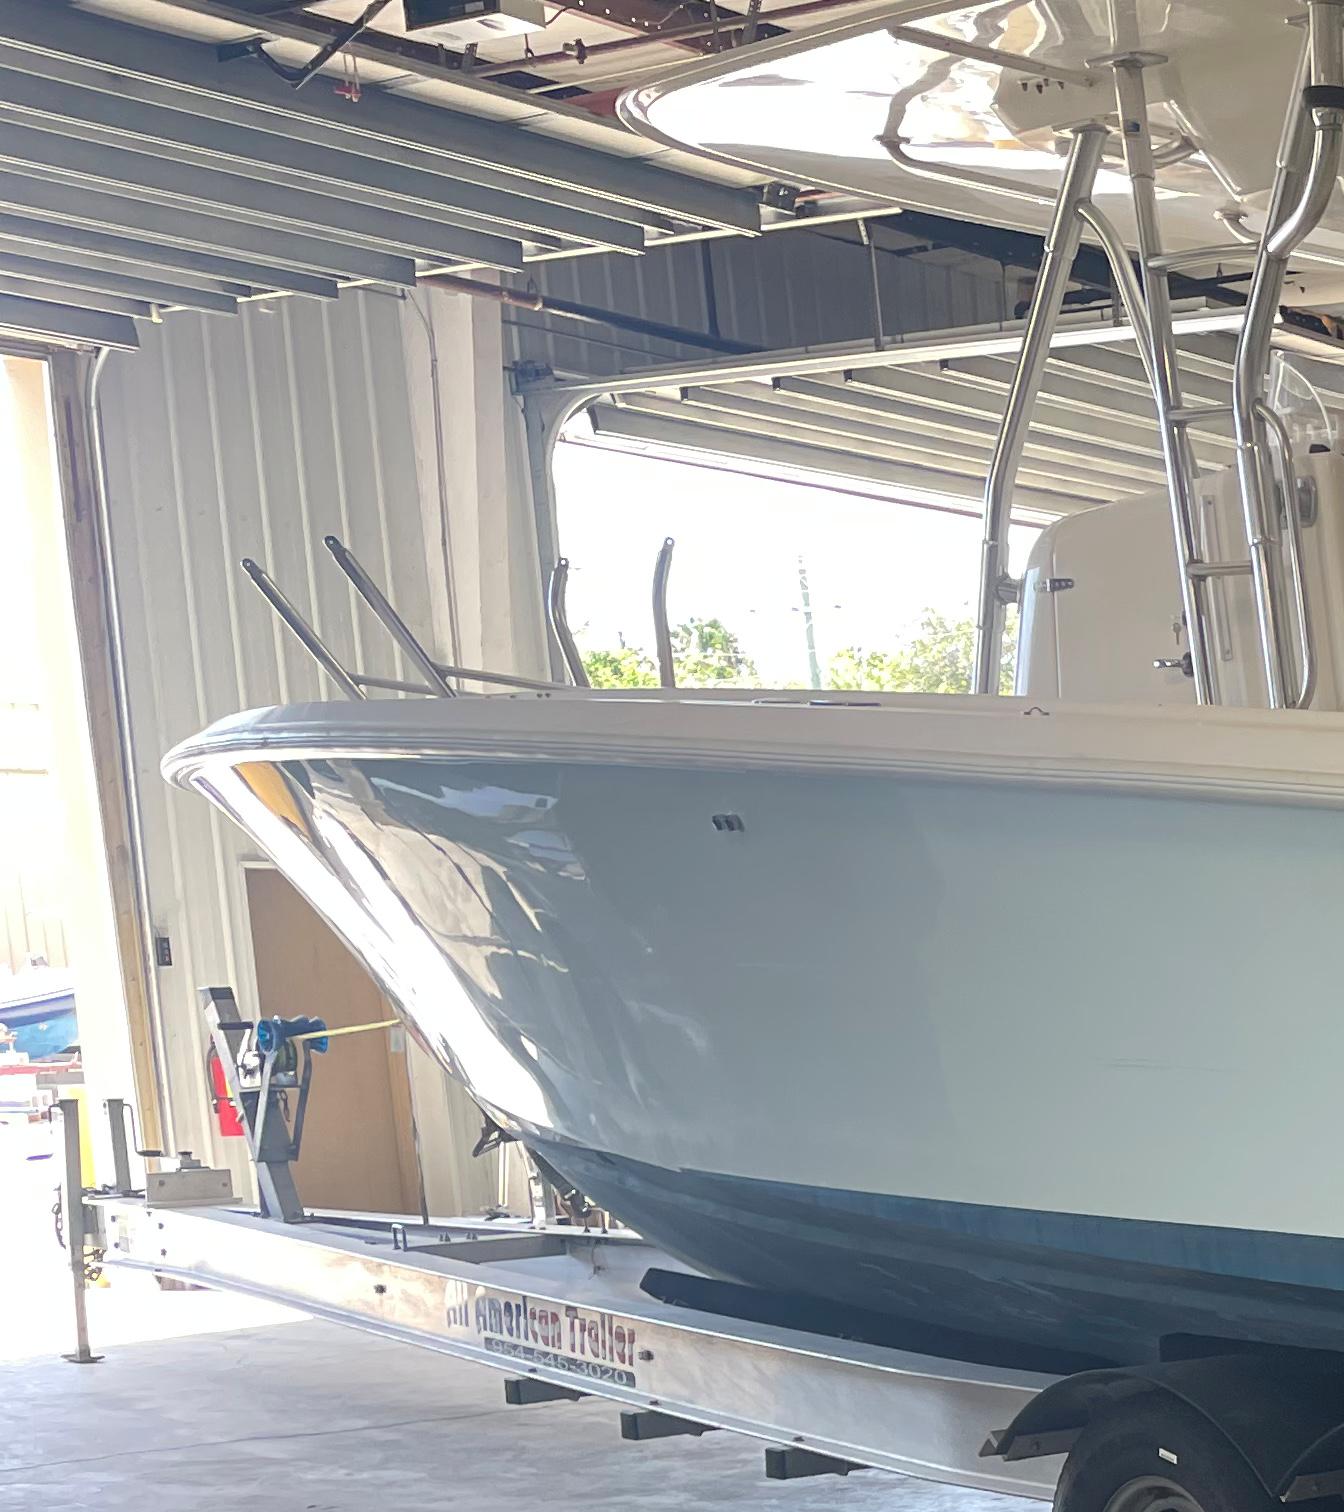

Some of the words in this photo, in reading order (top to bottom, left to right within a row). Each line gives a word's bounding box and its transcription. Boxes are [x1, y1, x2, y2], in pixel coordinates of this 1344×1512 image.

[475, 1286, 562, 1350] American
[565, 1305, 635, 1366] Trailer
[491, 1338, 628, 1385] 954-545-3020
